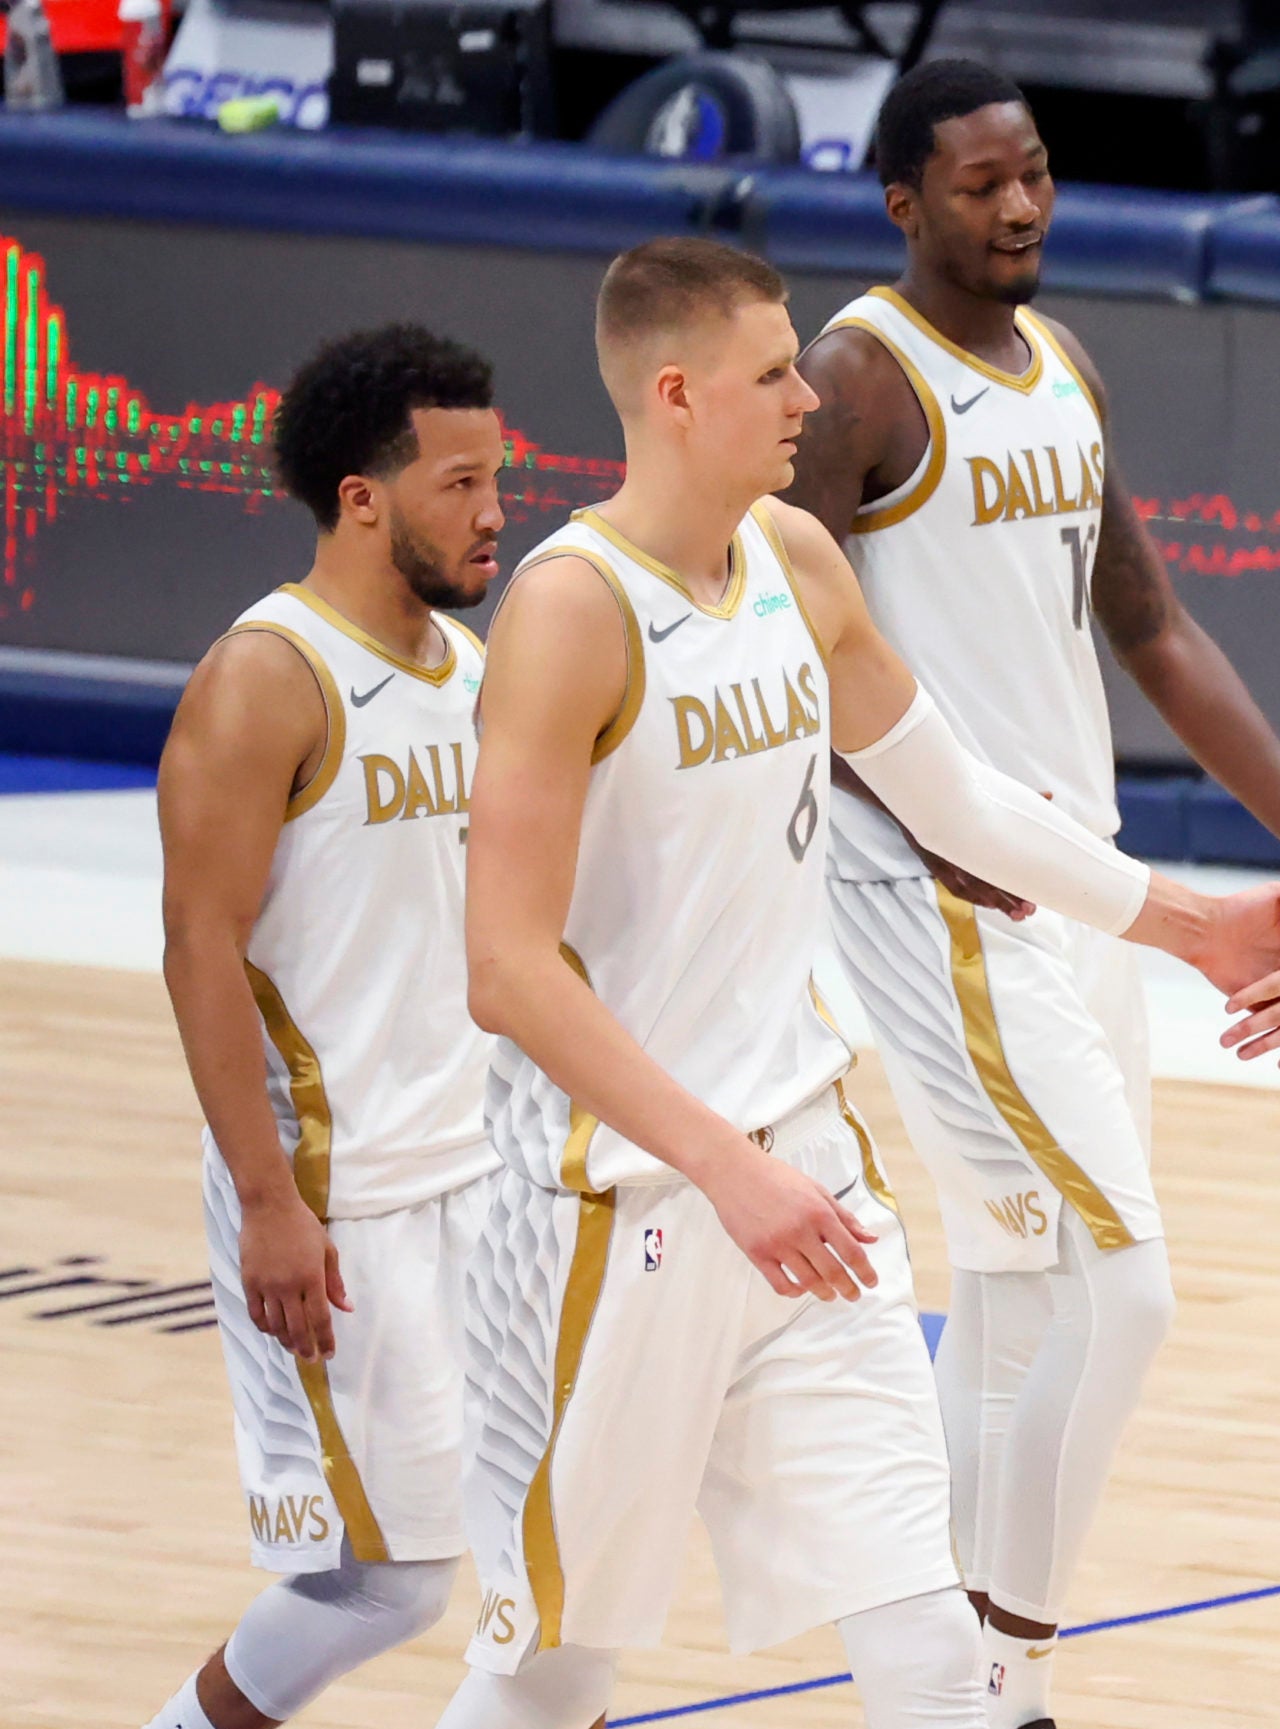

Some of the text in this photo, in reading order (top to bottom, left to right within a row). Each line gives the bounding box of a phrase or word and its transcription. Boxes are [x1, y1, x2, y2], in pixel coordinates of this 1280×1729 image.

[963, 440, 1104, 527] DALLAS
[666, 662, 821, 770] DALLAS
[786, 753, 818, 864] 6
[249, 1495, 329, 1543] MAVS
[477, 1587, 516, 1645] VS
